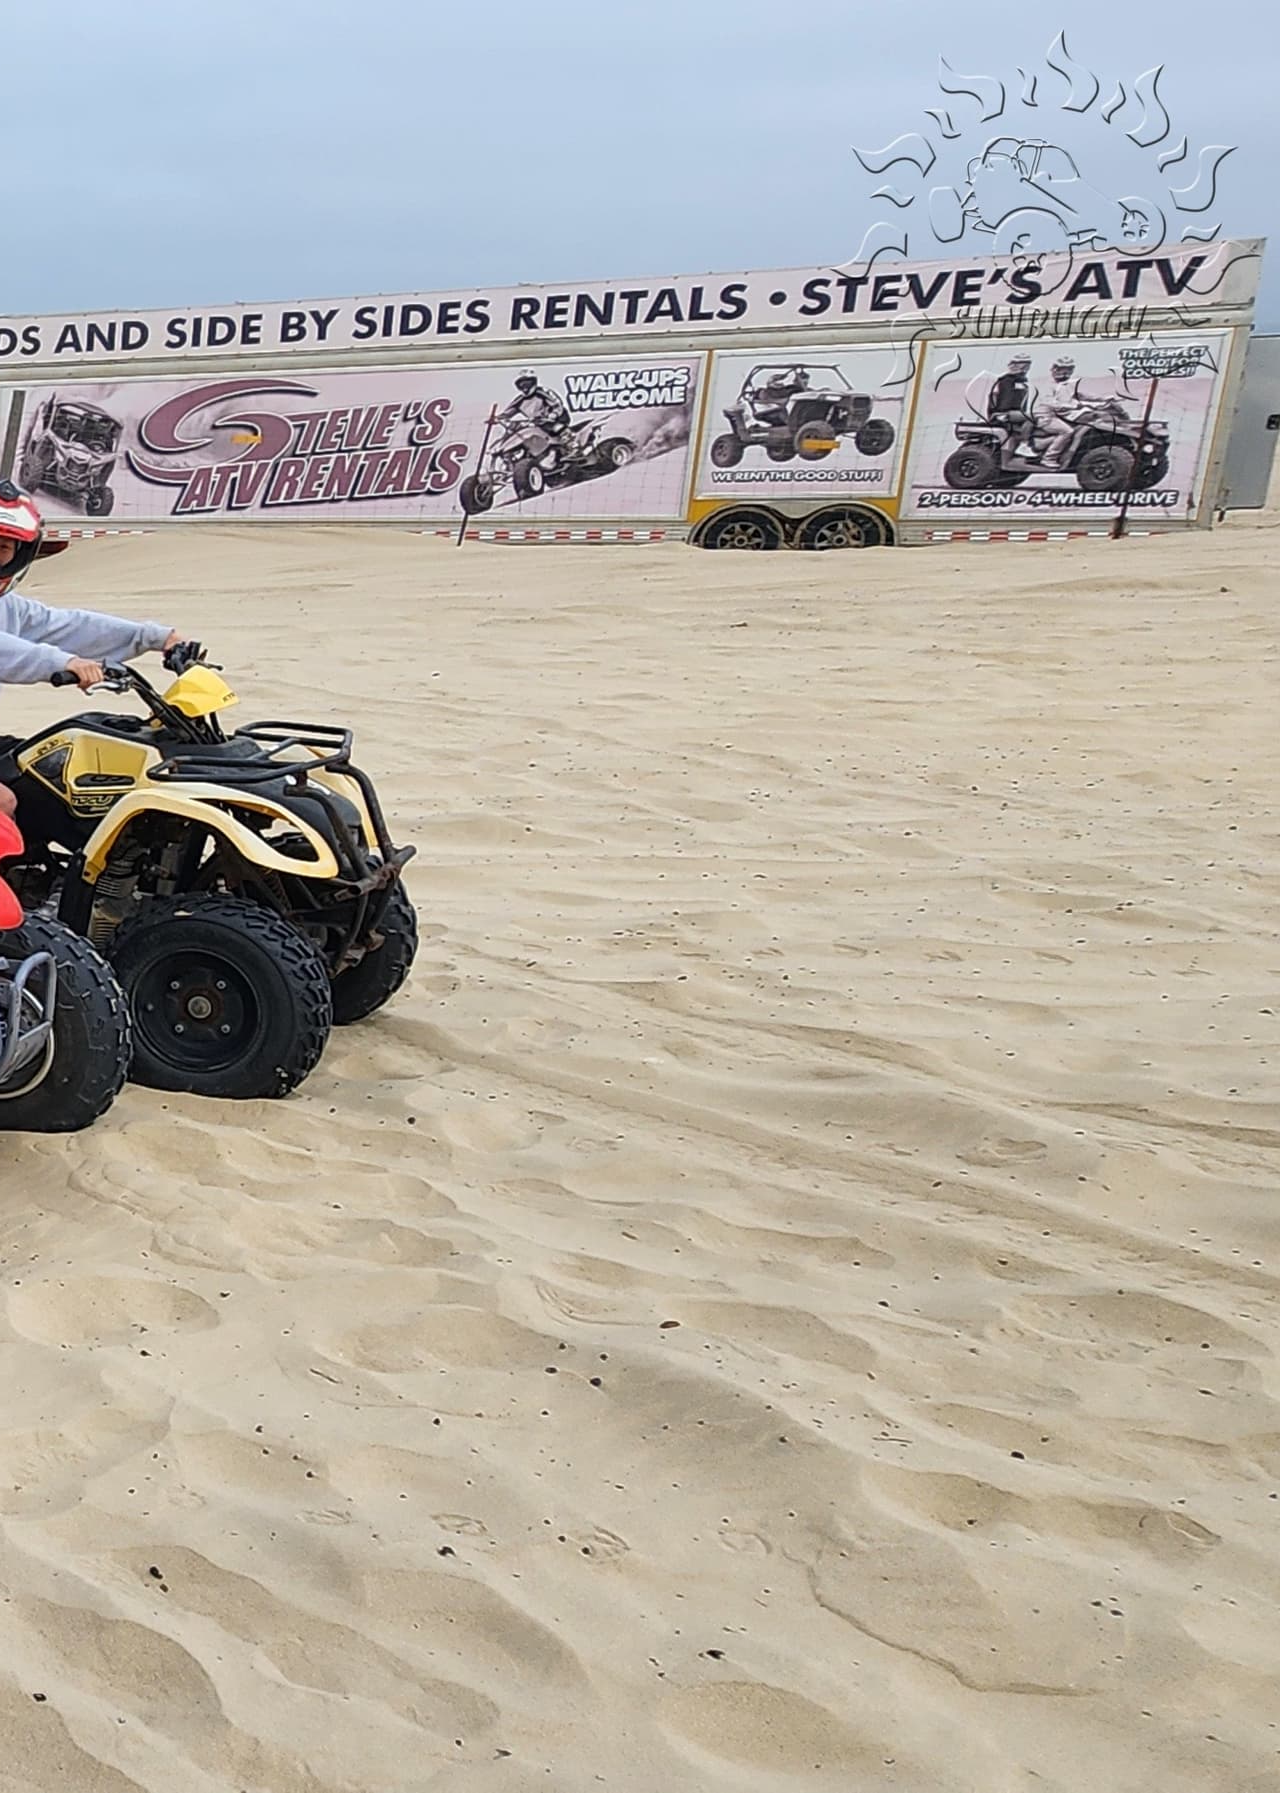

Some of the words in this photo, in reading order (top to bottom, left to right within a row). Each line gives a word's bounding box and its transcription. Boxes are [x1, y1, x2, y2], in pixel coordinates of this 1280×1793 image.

[53, 320, 149, 354] AND
[164, 314, 264, 349] SIDE
[279, 308, 340, 343] BY
[351, 299, 491, 340] SIDES
[509, 283, 748, 331] RENTALS
[797, 262, 1042, 317] STEVE'S
[1062, 254, 1208, 303] ATV
[1121, 349, 1146, 359] THE
[1150, 346, 1207, 358] PERFECT
[566, 366, 690, 393] WALK-UPS
[568, 386, 687, 411] WELCOME
[132, 379, 451, 474] STEVE'S
[173, 462, 269, 514] ATV
[262, 443, 468, 507] RENTALS
[712, 471, 732, 481] WE
[734, 471, 768, 481] RENT
[769, 471, 792, 481] THE
[794, 471, 837, 481] GOOD
[839, 470, 883, 481] STUFF!
[919, 492, 1012, 507] 2-PERSON
[1028, 491, 1116, 505] 4-WHEEL
